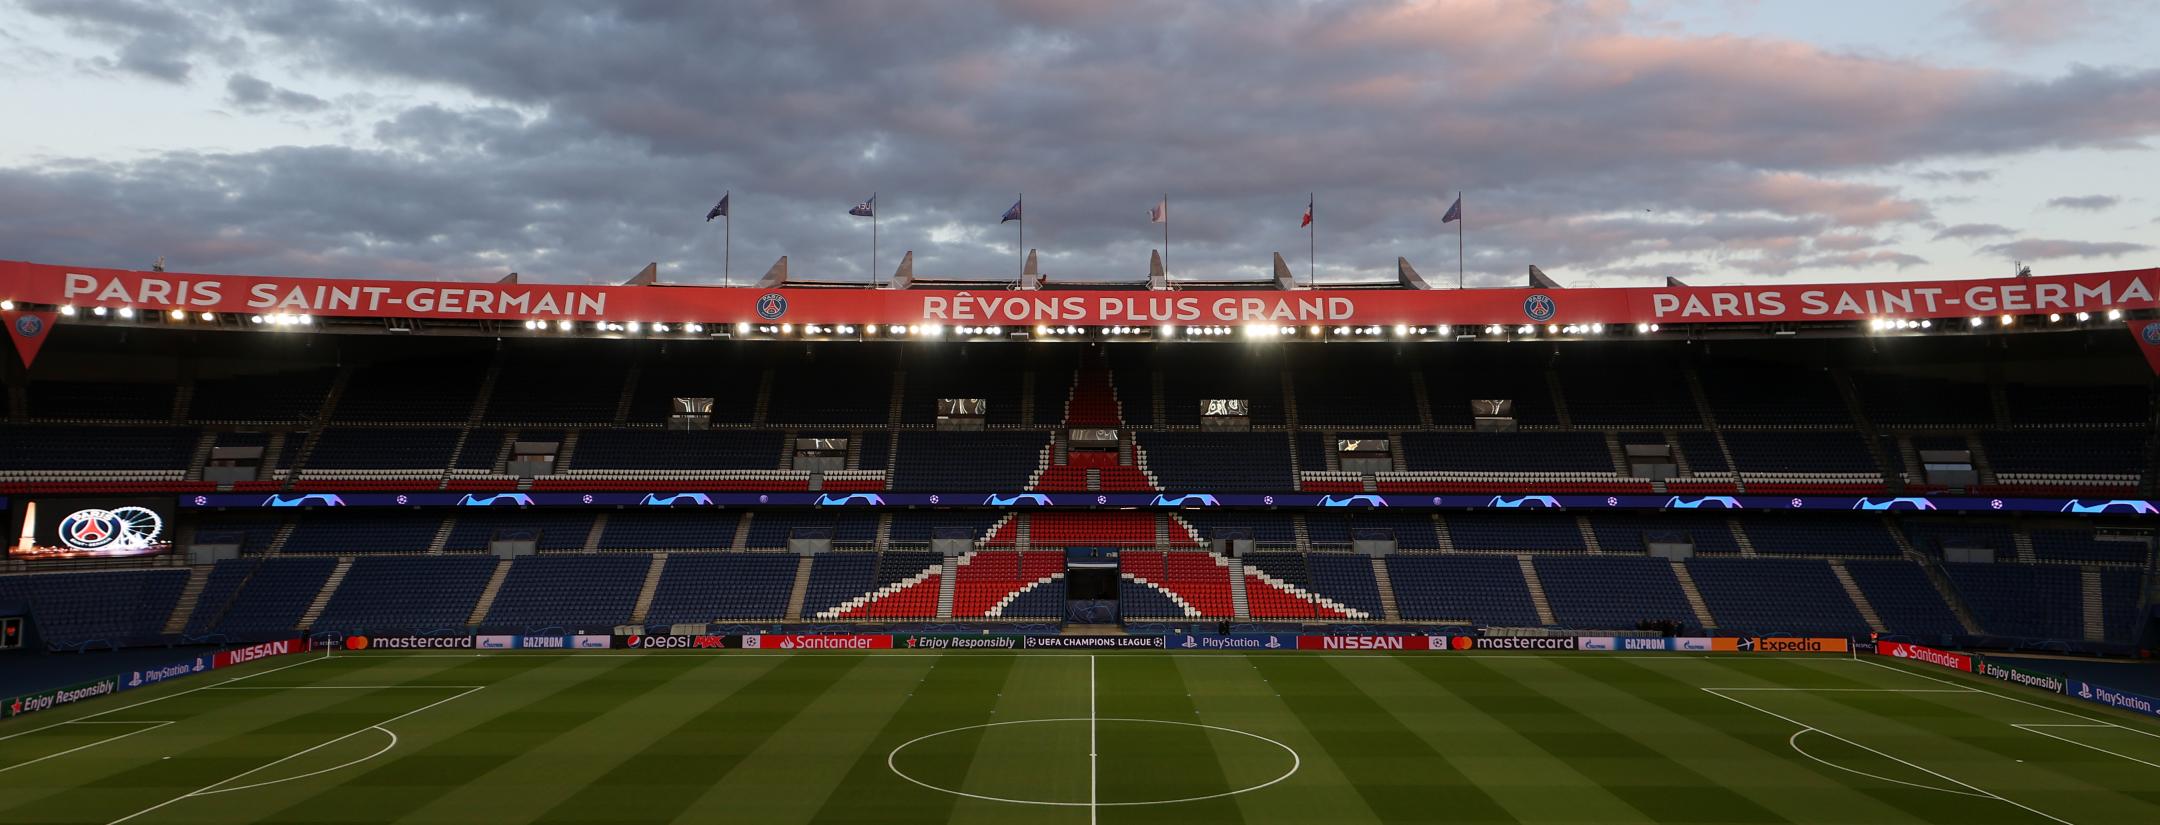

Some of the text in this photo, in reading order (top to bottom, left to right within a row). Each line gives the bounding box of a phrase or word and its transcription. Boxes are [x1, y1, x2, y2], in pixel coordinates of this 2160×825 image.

[64, 273, 606, 316] PARIS SAINT-GERMAIN
[1653, 276, 2160, 317] PARIS SAINT-GERMA
[923, 292, 1355, 321] RÊVONS PLUS GRAND
[372, 636, 472, 649] mastercard
[523, 637, 563, 648] GAZPROM
[644, 635, 691, 649] pepsi
[796, 636, 872, 649] Santander
[919, 637, 1015, 649] Enjoy Responsibly
[1038, 638, 1151, 646] UEFA CHAMPIONS LEAGUE
[1202, 637, 1260, 649] PlayStation
[1324, 637, 1402, 649] NISSAN
[1477, 637, 1573, 649] mastercard
[1625, 639, 1665, 650] GAZPROM
[1760, 638, 1821, 650] Expedia
[230, 641, 288, 664] NISSAN
[1909, 645, 1960, 668] Santander
[145, 664, 189, 682] PlayStation
[1987, 664, 2062, 694] Enjoy Responsibly
[24, 680, 114, 710] Enjoy Responsibly
[2096, 688, 2152, 713] PlayStation
